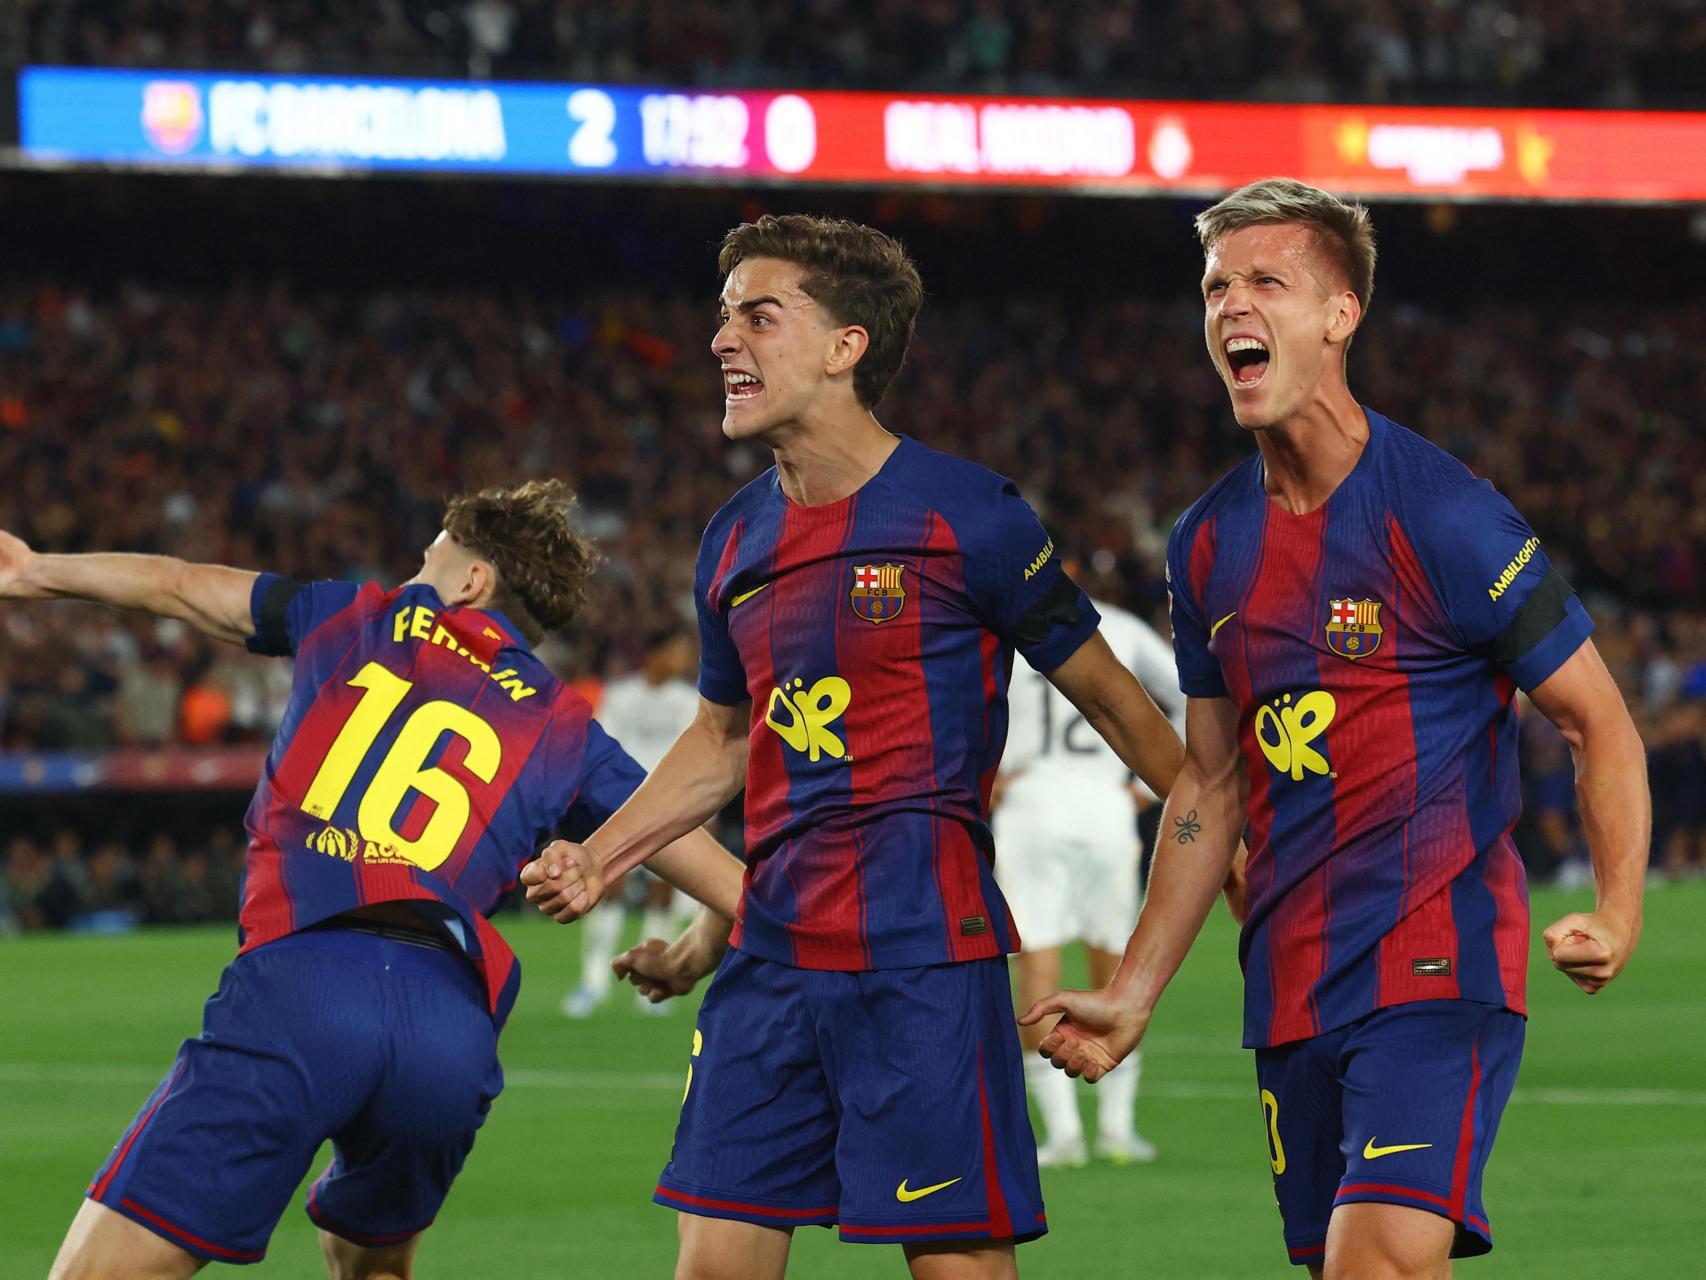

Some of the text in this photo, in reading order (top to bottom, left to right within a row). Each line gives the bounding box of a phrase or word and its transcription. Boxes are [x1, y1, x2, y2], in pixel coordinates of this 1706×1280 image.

[566, 88, 617, 166] 2
[764, 94, 817, 173] 0
[1343, 624, 1366, 632] FCB
[300, 661, 502, 872] 16
